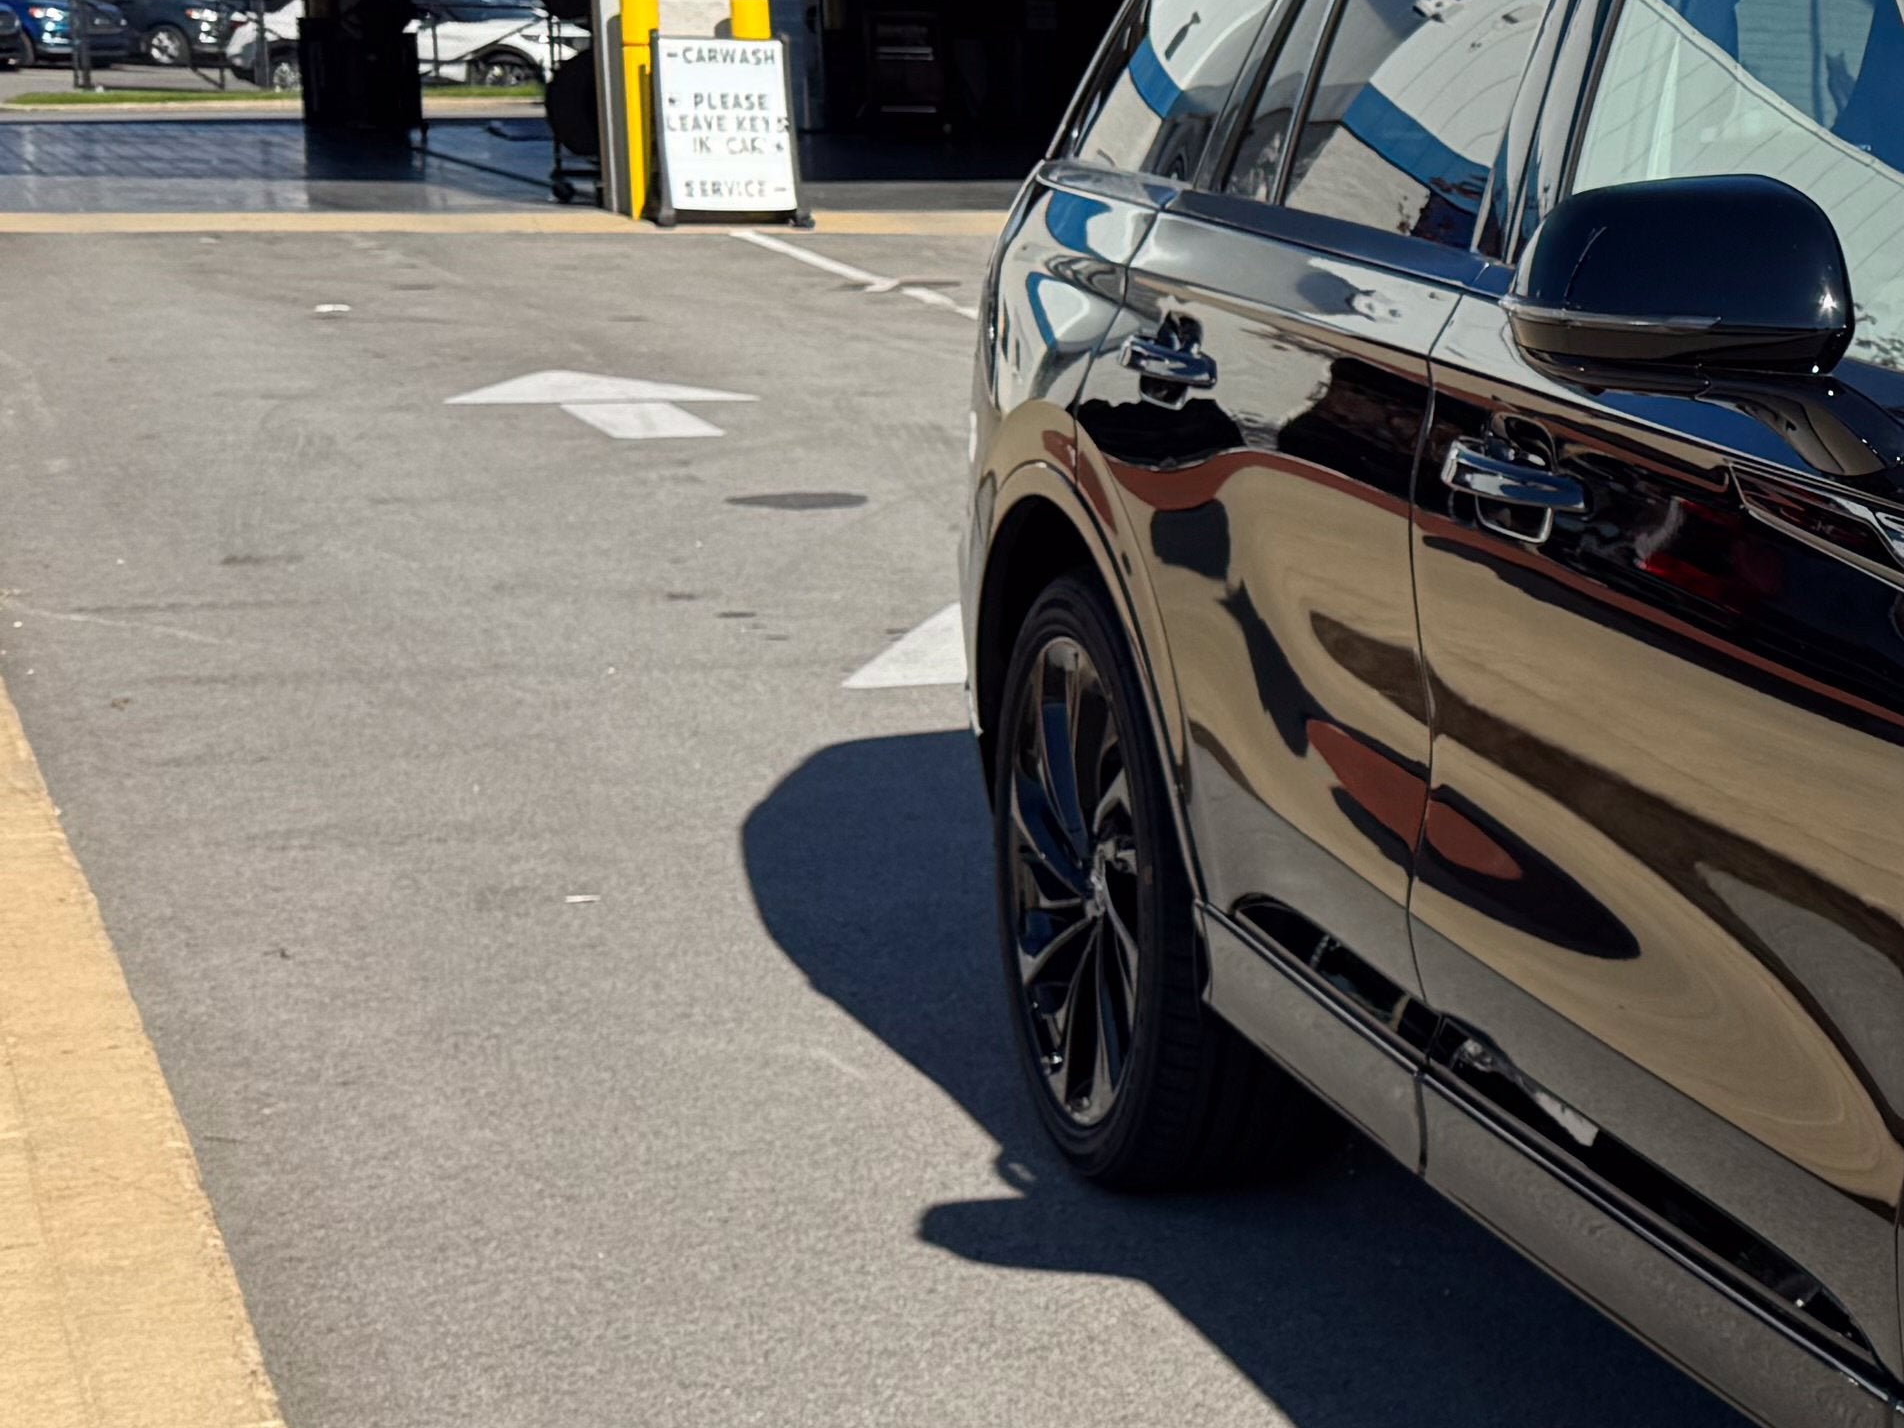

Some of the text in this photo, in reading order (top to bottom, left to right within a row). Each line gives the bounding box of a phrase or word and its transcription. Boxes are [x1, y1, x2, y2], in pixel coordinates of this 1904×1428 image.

[682, 47, 776, 65] CARWASH
[693, 92, 769, 111] PLEASE
[667, 113, 790, 133] LEAVE KEYS
[692, 137, 764, 154] IN CAR
[684, 180, 768, 197] SERVICE
